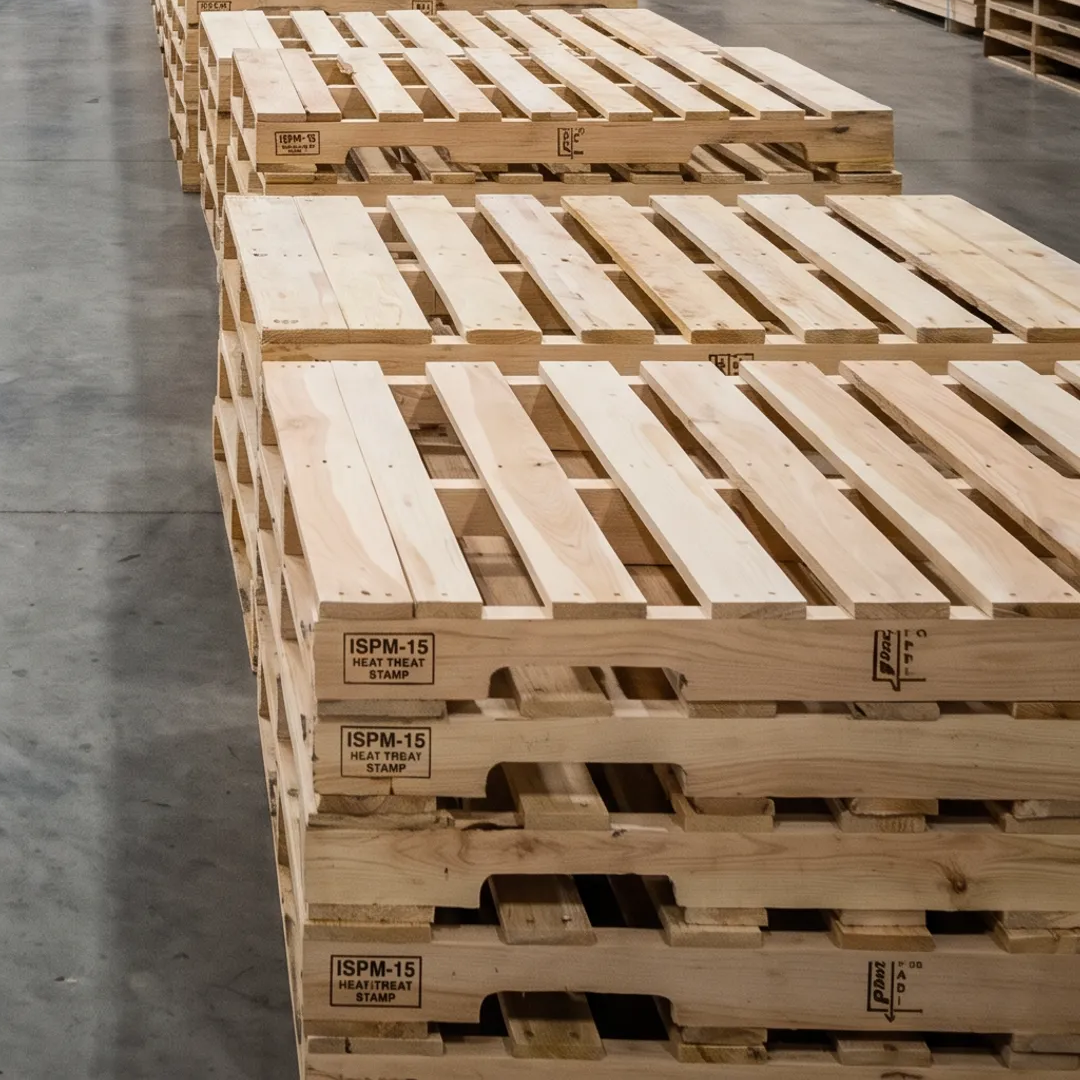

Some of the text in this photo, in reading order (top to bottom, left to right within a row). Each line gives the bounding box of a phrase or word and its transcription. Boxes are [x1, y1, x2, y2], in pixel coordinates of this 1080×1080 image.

[349, 638, 429, 655] ISPM-15
[352, 658, 383, 668] HEAT
[369, 670, 409, 680] STAMP
[347, 731, 426, 749] ISPM-15
[350, 751, 380, 761] HEAT
[366, 763, 406, 773] STAMP
[336, 960, 416, 978] ISPM-15
[355, 992, 396, 1003] STAMP
